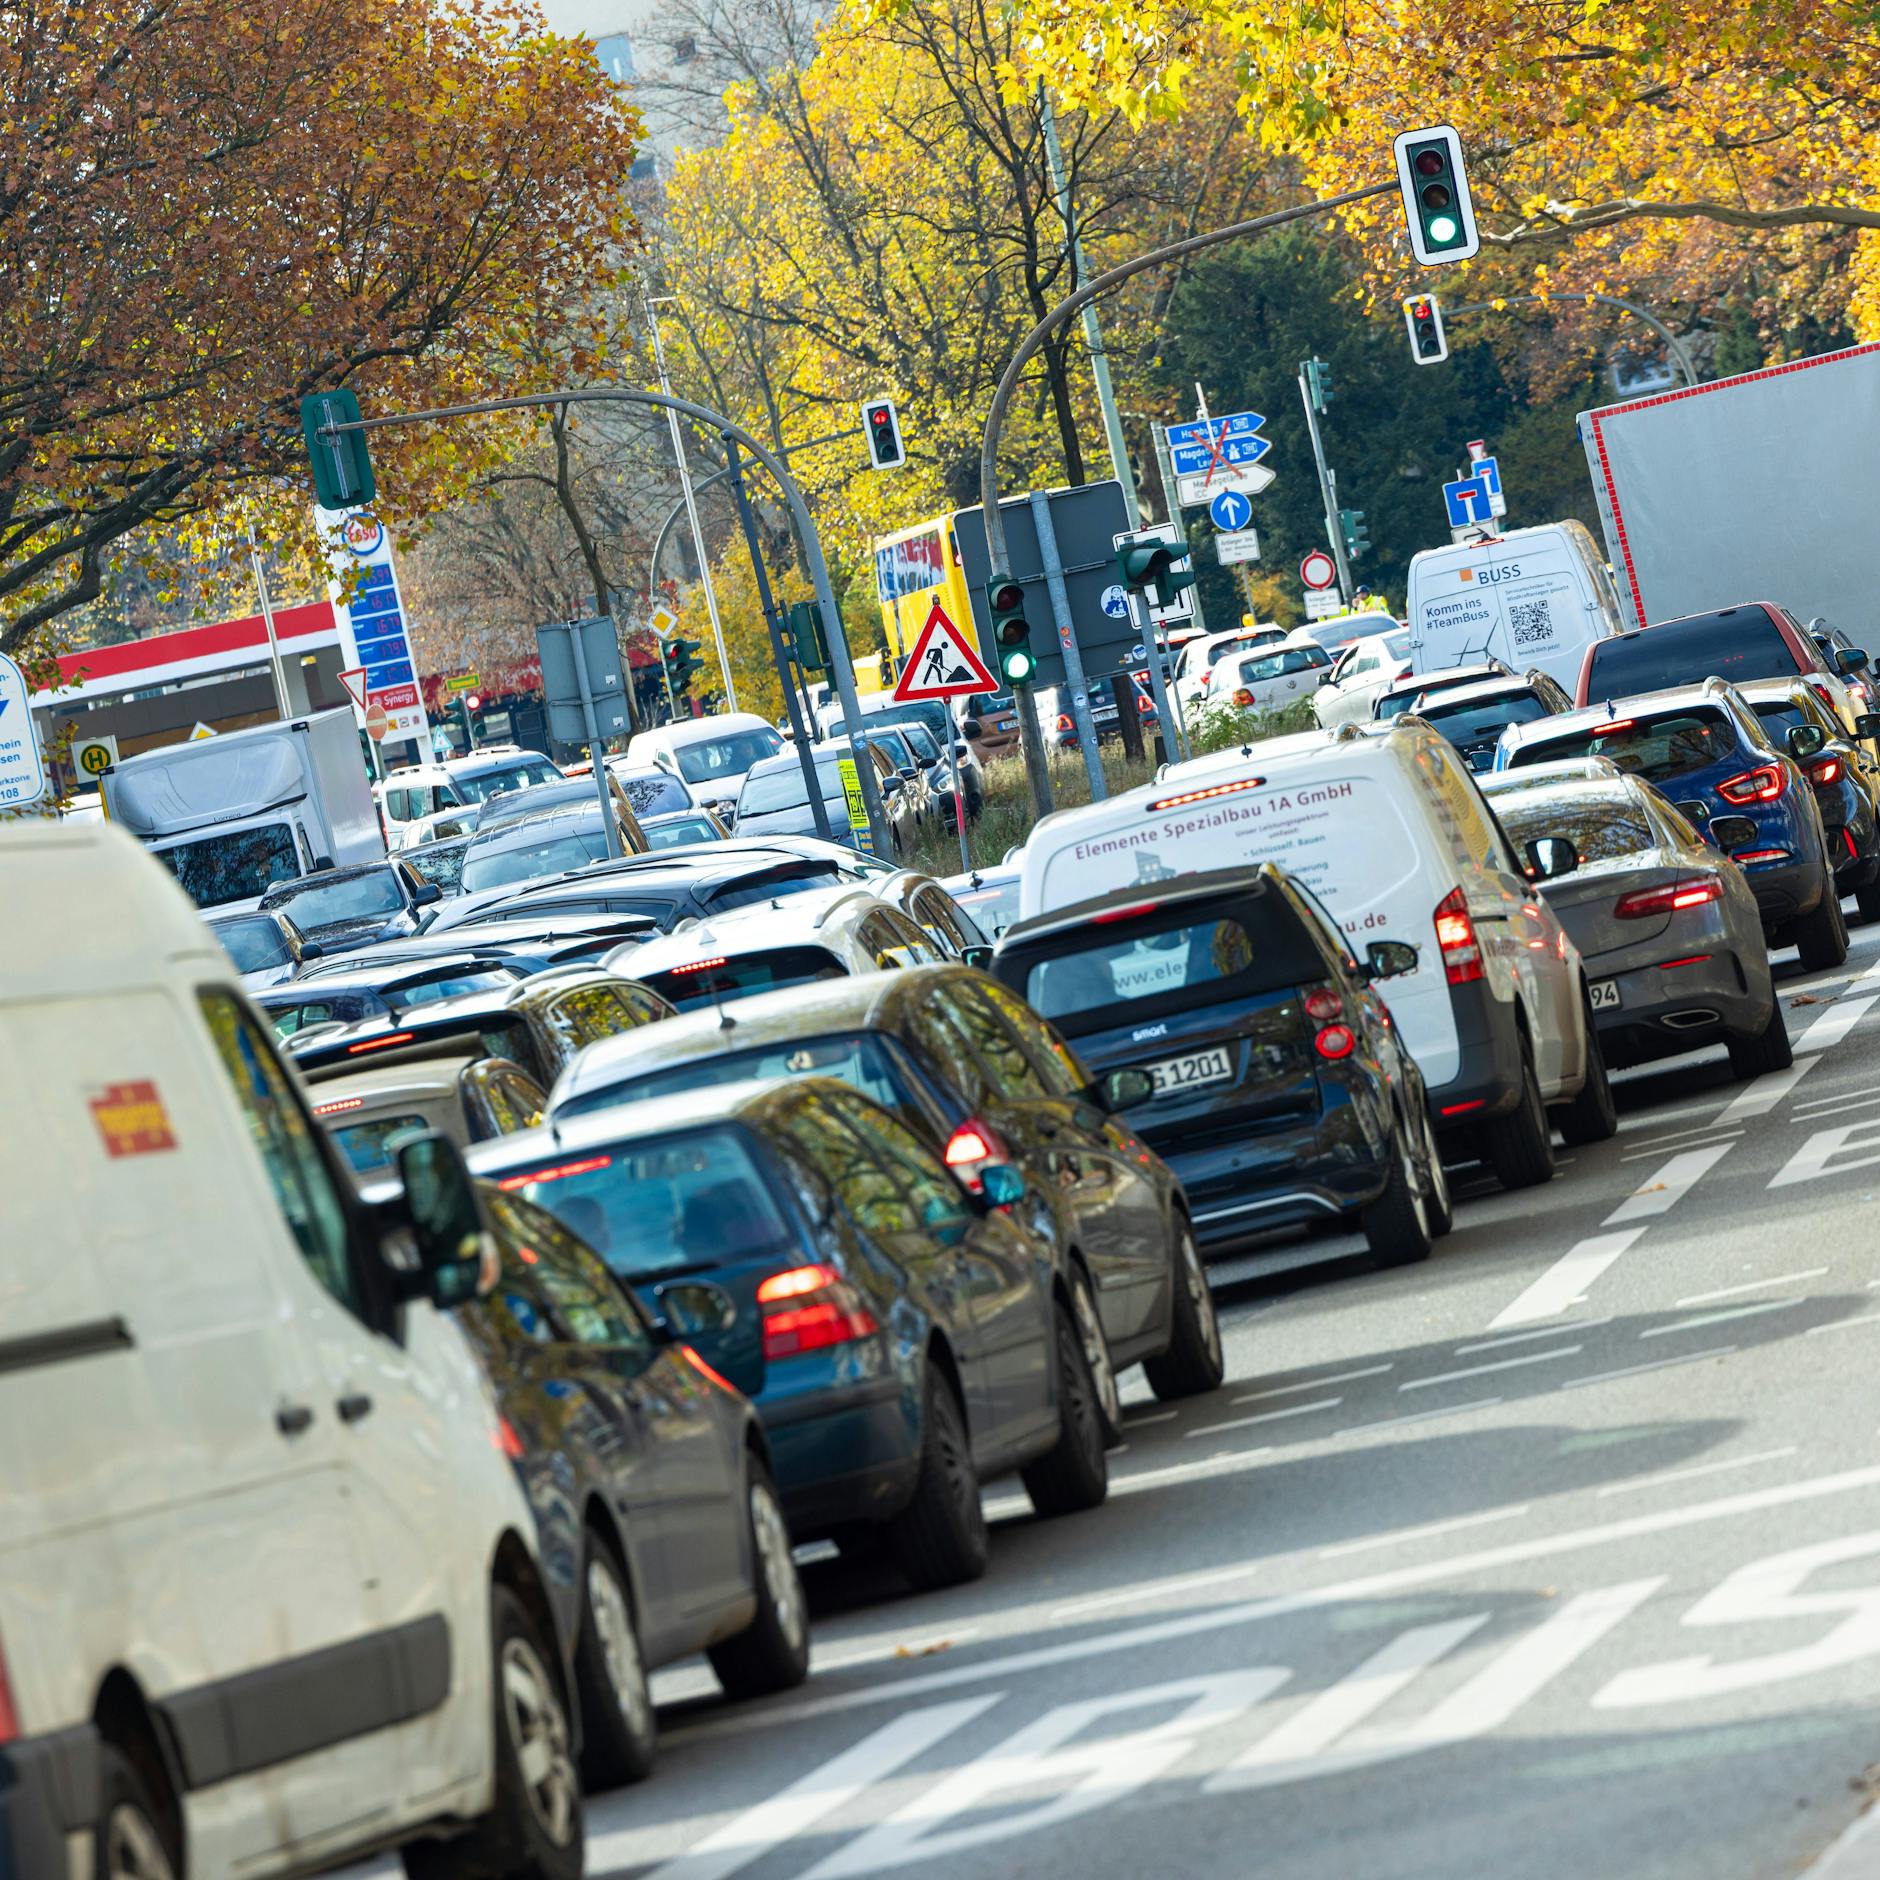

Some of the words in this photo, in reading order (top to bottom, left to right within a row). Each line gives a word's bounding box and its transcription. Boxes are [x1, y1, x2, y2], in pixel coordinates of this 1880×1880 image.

[1181, 425, 1218, 439] Habug
[1179, 446, 1225, 461] Magdeg
[1478, 564, 1521, 585] BUSS
[1426, 603, 1463, 618] Komm
[1464, 599, 1482, 610] ins
[1426, 610, 1490, 631] #TeamBuss
[383, 693, 414, 707] Synergy
[88, 751, 104, 769] H
[1075, 829, 1158, 861] Elemente
[1163, 805, 1263, 840] Spezialbau
[1268, 794, 1292, 813] 1A
[1297, 782, 1353, 806] GmbH
[1297, 835, 1326, 846] Bauen
[1337, 912, 1387, 933] u.de
[1591, 984, 1616, 1006] 94
[1132, 1023, 1168, 1042] smart
[1169, 1052, 1227, 1085] 1201
